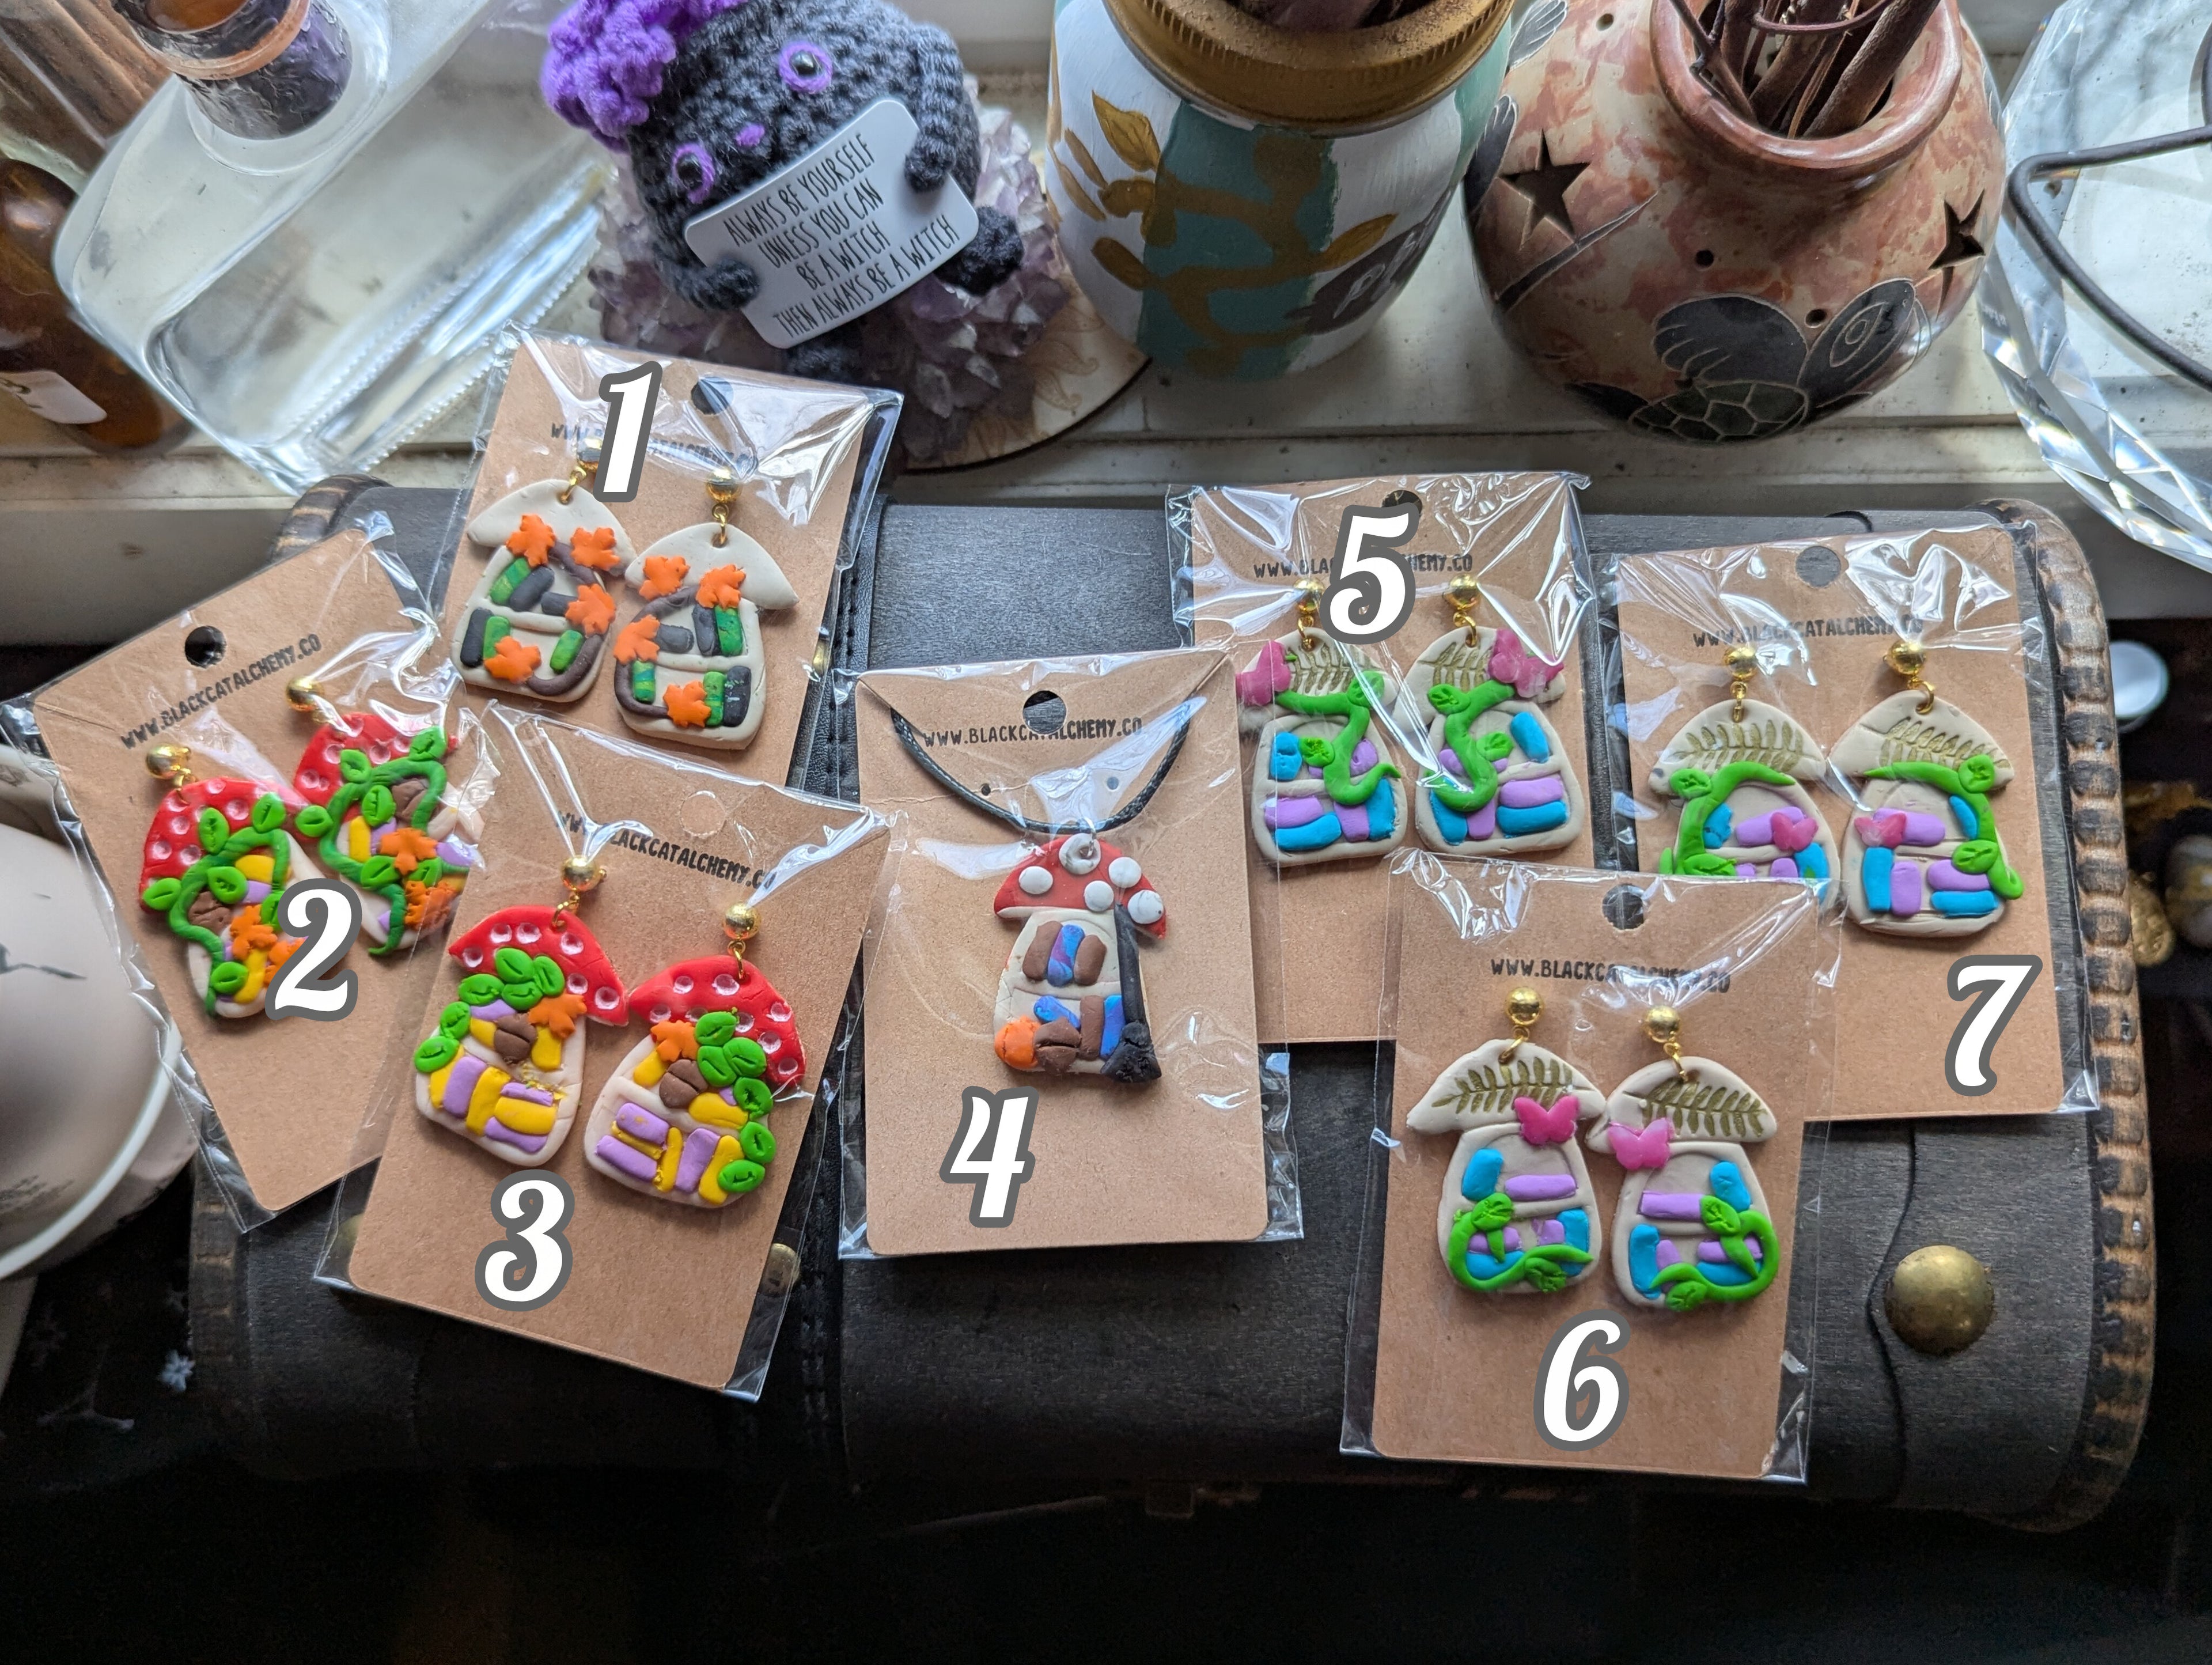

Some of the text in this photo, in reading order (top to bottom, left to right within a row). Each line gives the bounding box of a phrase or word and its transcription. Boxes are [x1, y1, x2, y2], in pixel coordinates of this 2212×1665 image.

[724, 133, 875, 247] ALWAYS BE YOURSELF
[758, 177, 884, 268] UNLESS YOU CAN
[773, 214, 960, 338] THEN ALWAYS BE A WITCH
[796, 221, 891, 290] BE A WITCH
[120, 633, 322, 749] WWW.BLACKCATALCHEMY.CO
